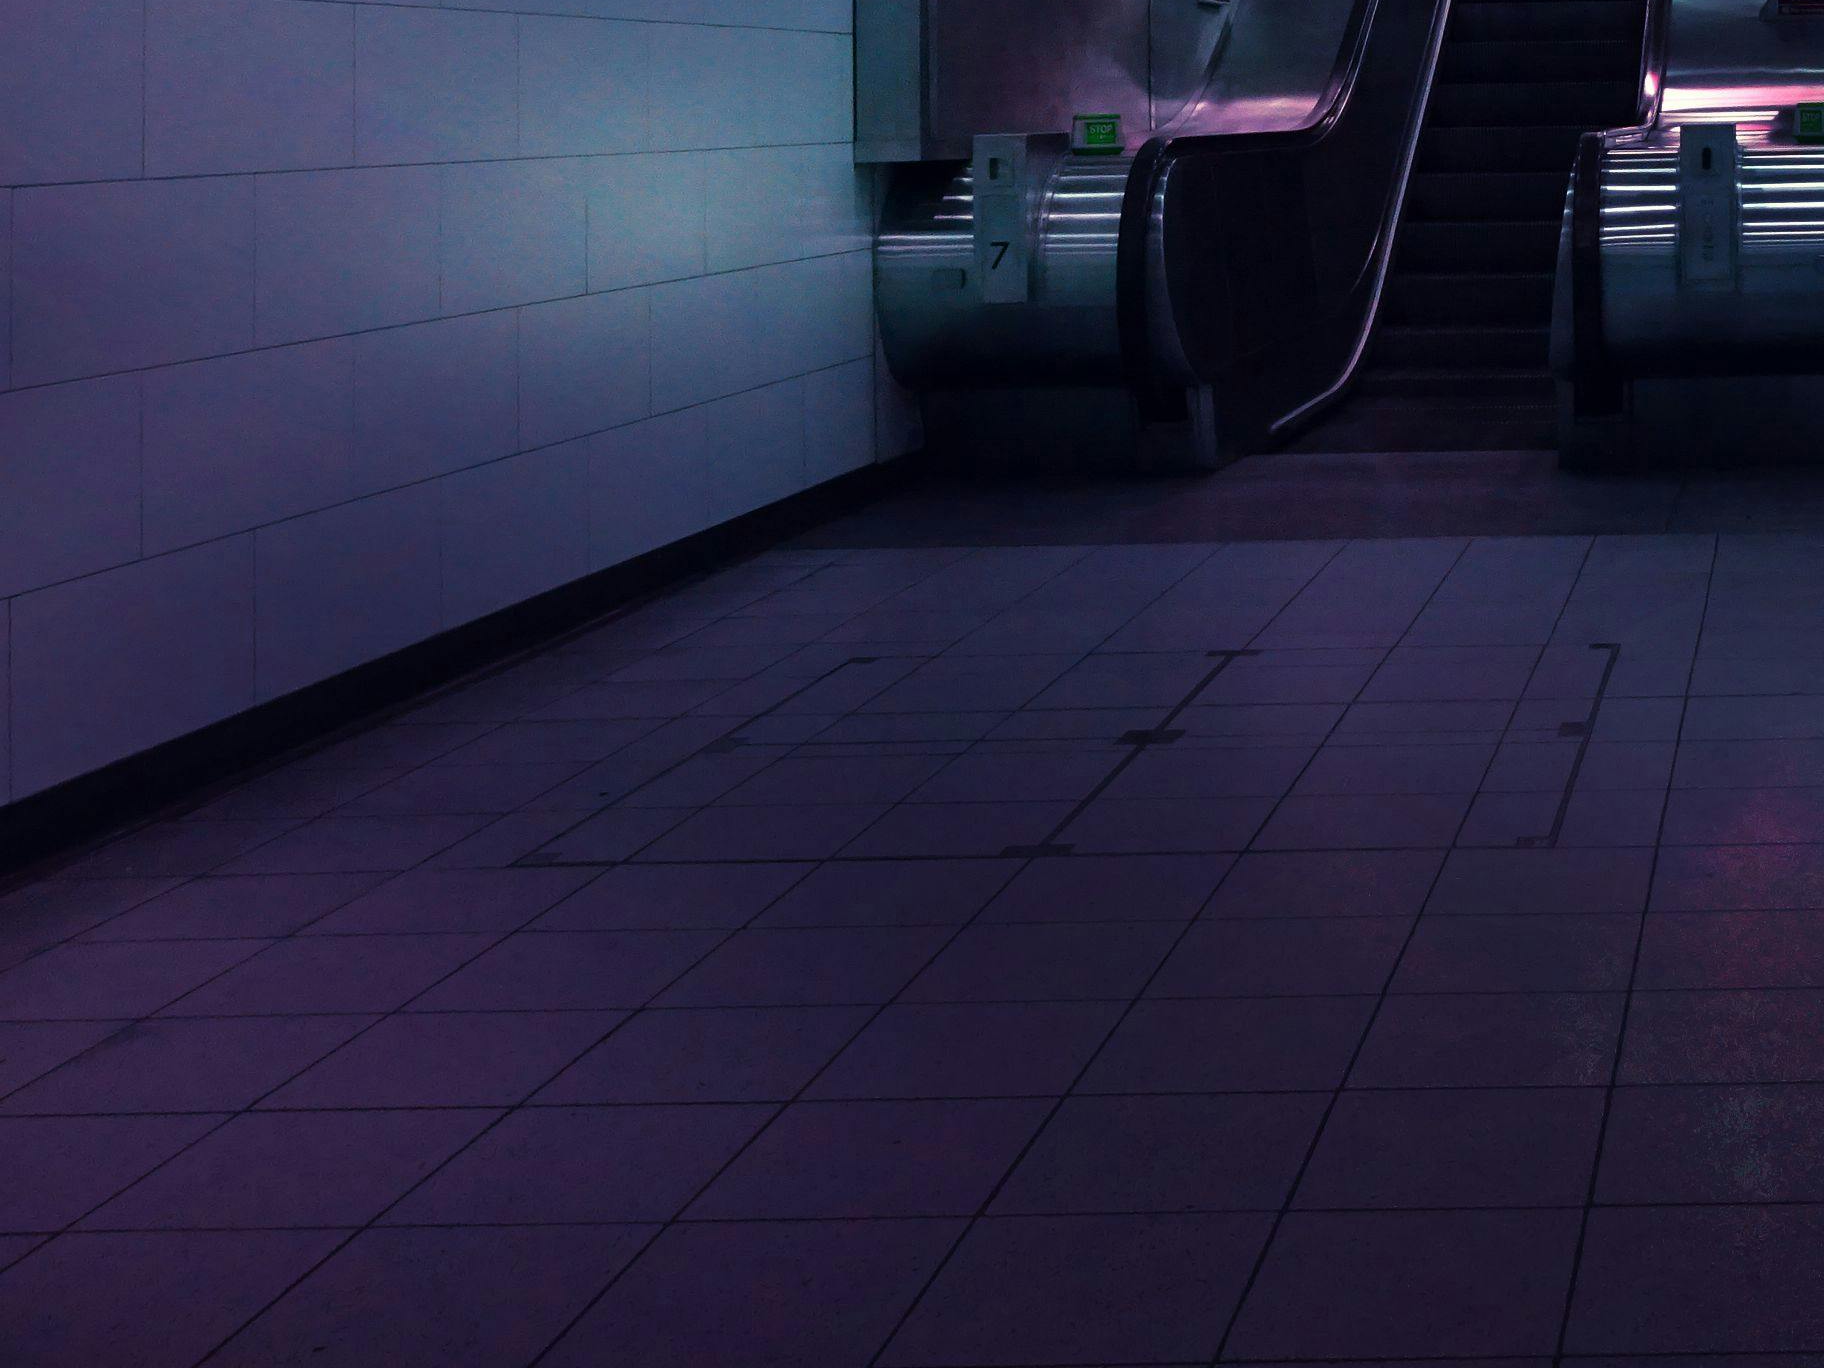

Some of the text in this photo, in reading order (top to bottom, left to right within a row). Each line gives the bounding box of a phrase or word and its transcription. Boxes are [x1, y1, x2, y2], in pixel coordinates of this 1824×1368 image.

[1801, 112, 1821, 121] STOP
[1089, 124, 1113, 135] STOP
[990, 241, 1010, 269] 7
